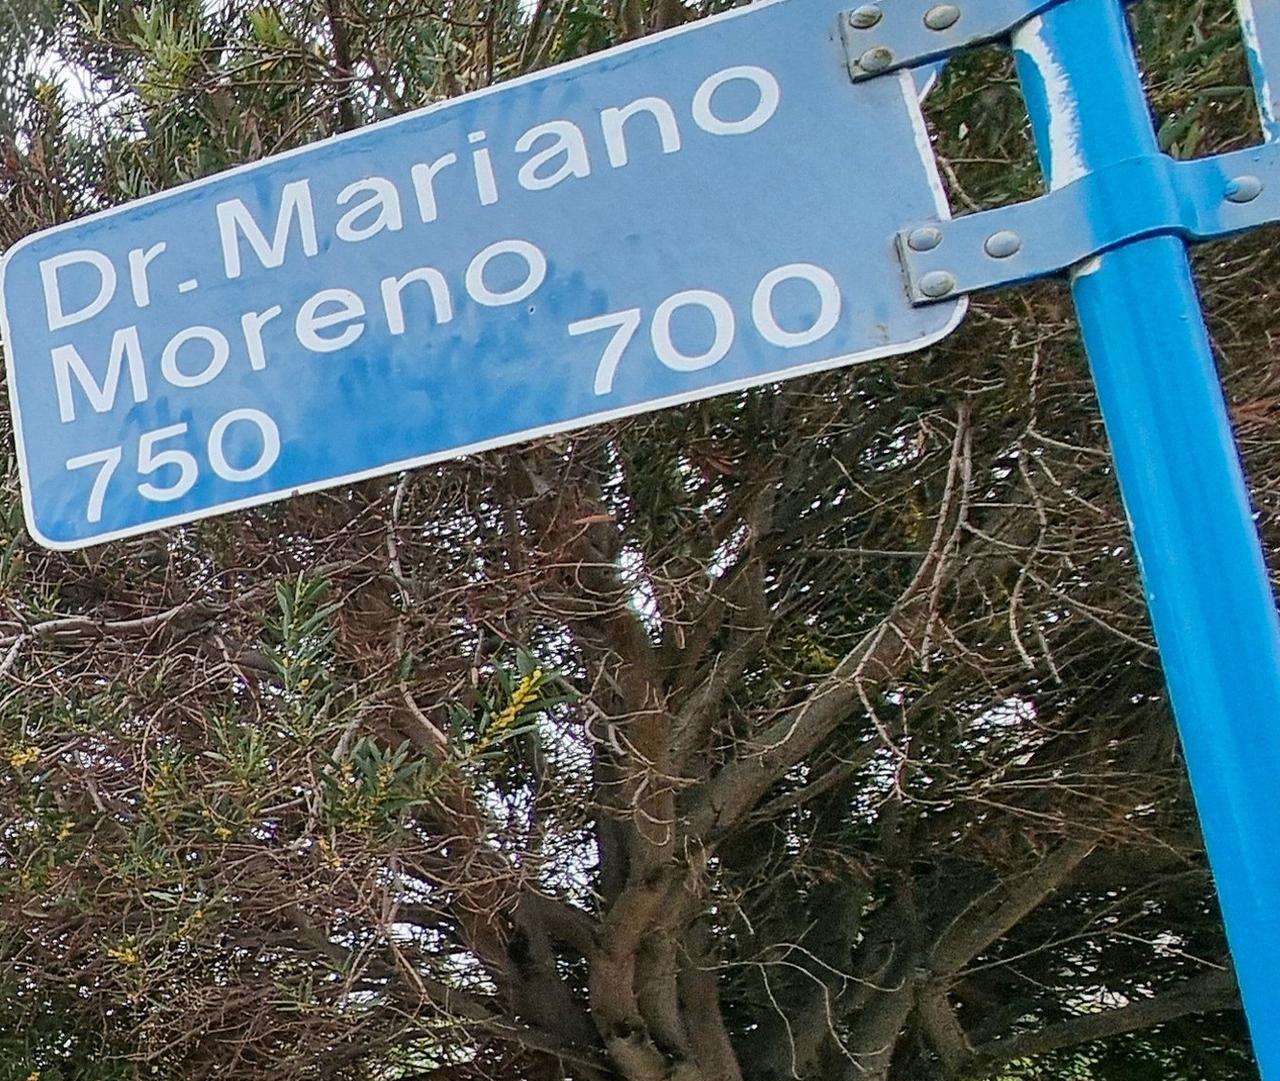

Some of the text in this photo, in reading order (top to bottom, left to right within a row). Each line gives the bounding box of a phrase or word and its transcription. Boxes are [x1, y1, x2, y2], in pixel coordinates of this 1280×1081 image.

[39, 65, 781, 332] Dr. Mariano
[50, 239, 547, 423] Moreno
[65, 262, 842, 523] 750 700
